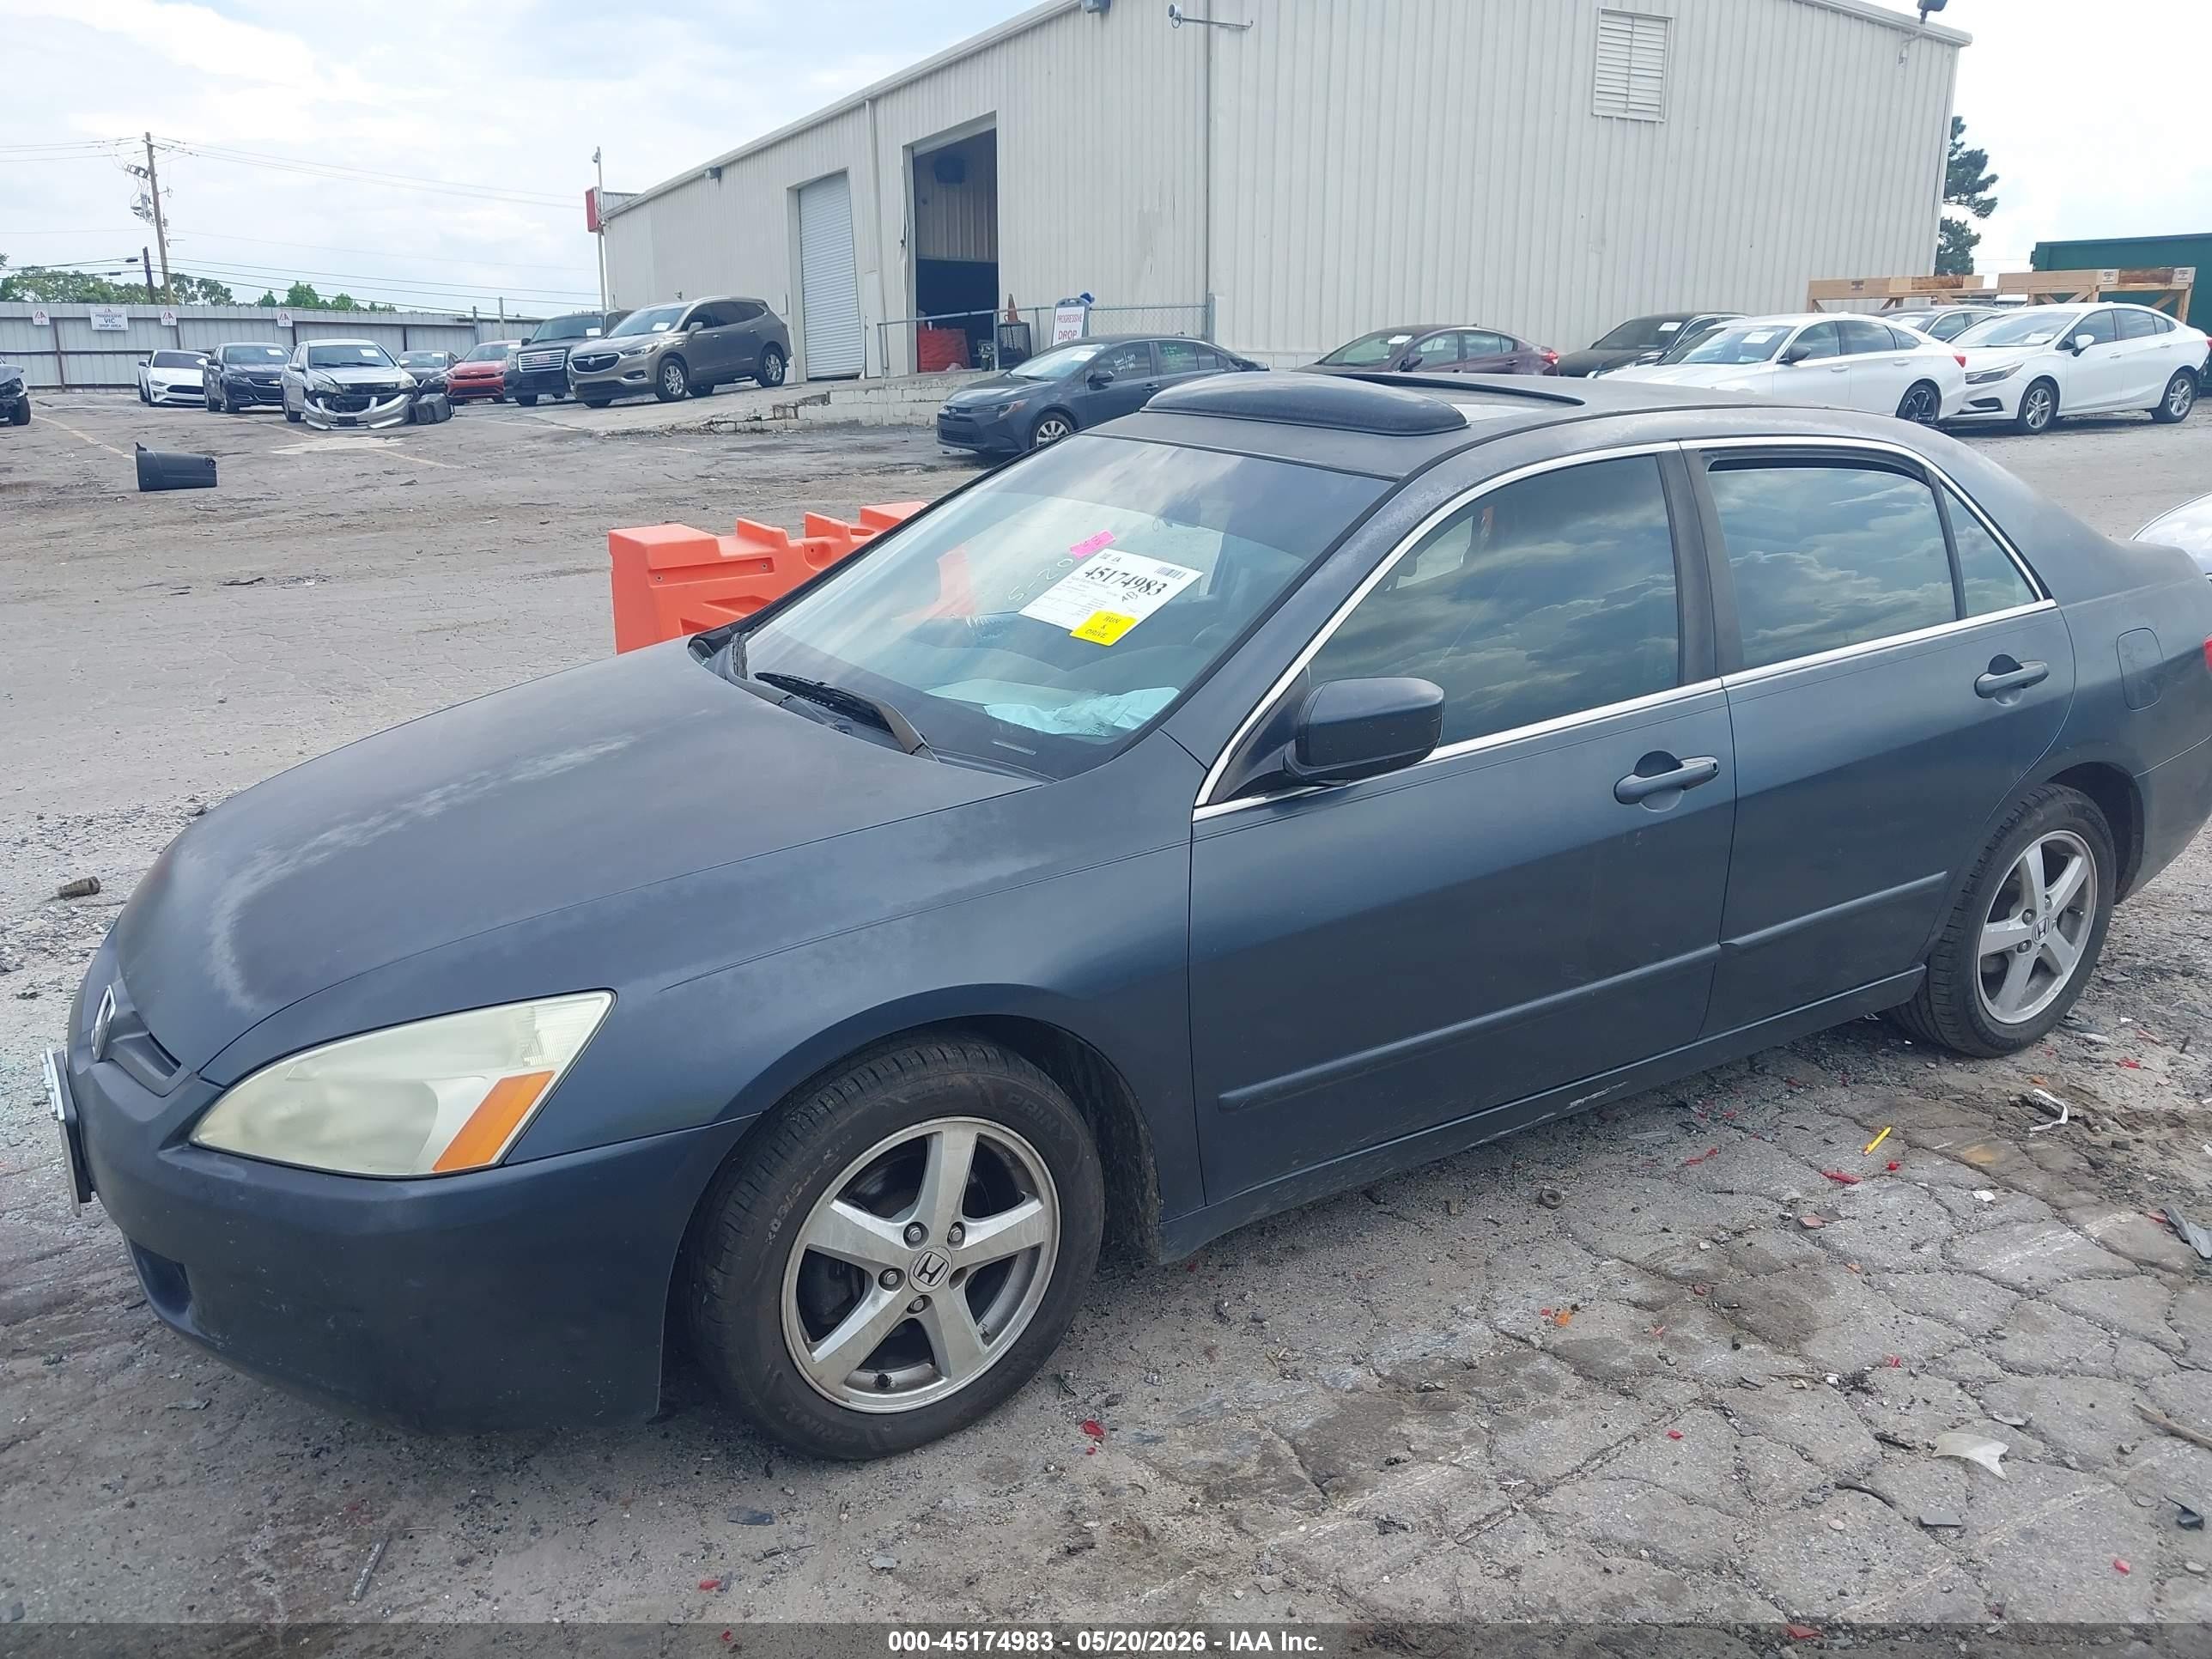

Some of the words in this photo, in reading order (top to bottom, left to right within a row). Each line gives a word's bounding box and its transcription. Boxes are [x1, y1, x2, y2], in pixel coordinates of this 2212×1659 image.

[1057, 313, 1083, 324] PROGRESSIVE
[1058, 330, 1078, 340] DROP
[1084, 566, 1168, 596] 45174983
[1103, 616, 1121, 624] RUN
[1085, 629, 1109, 639] DRIVE
